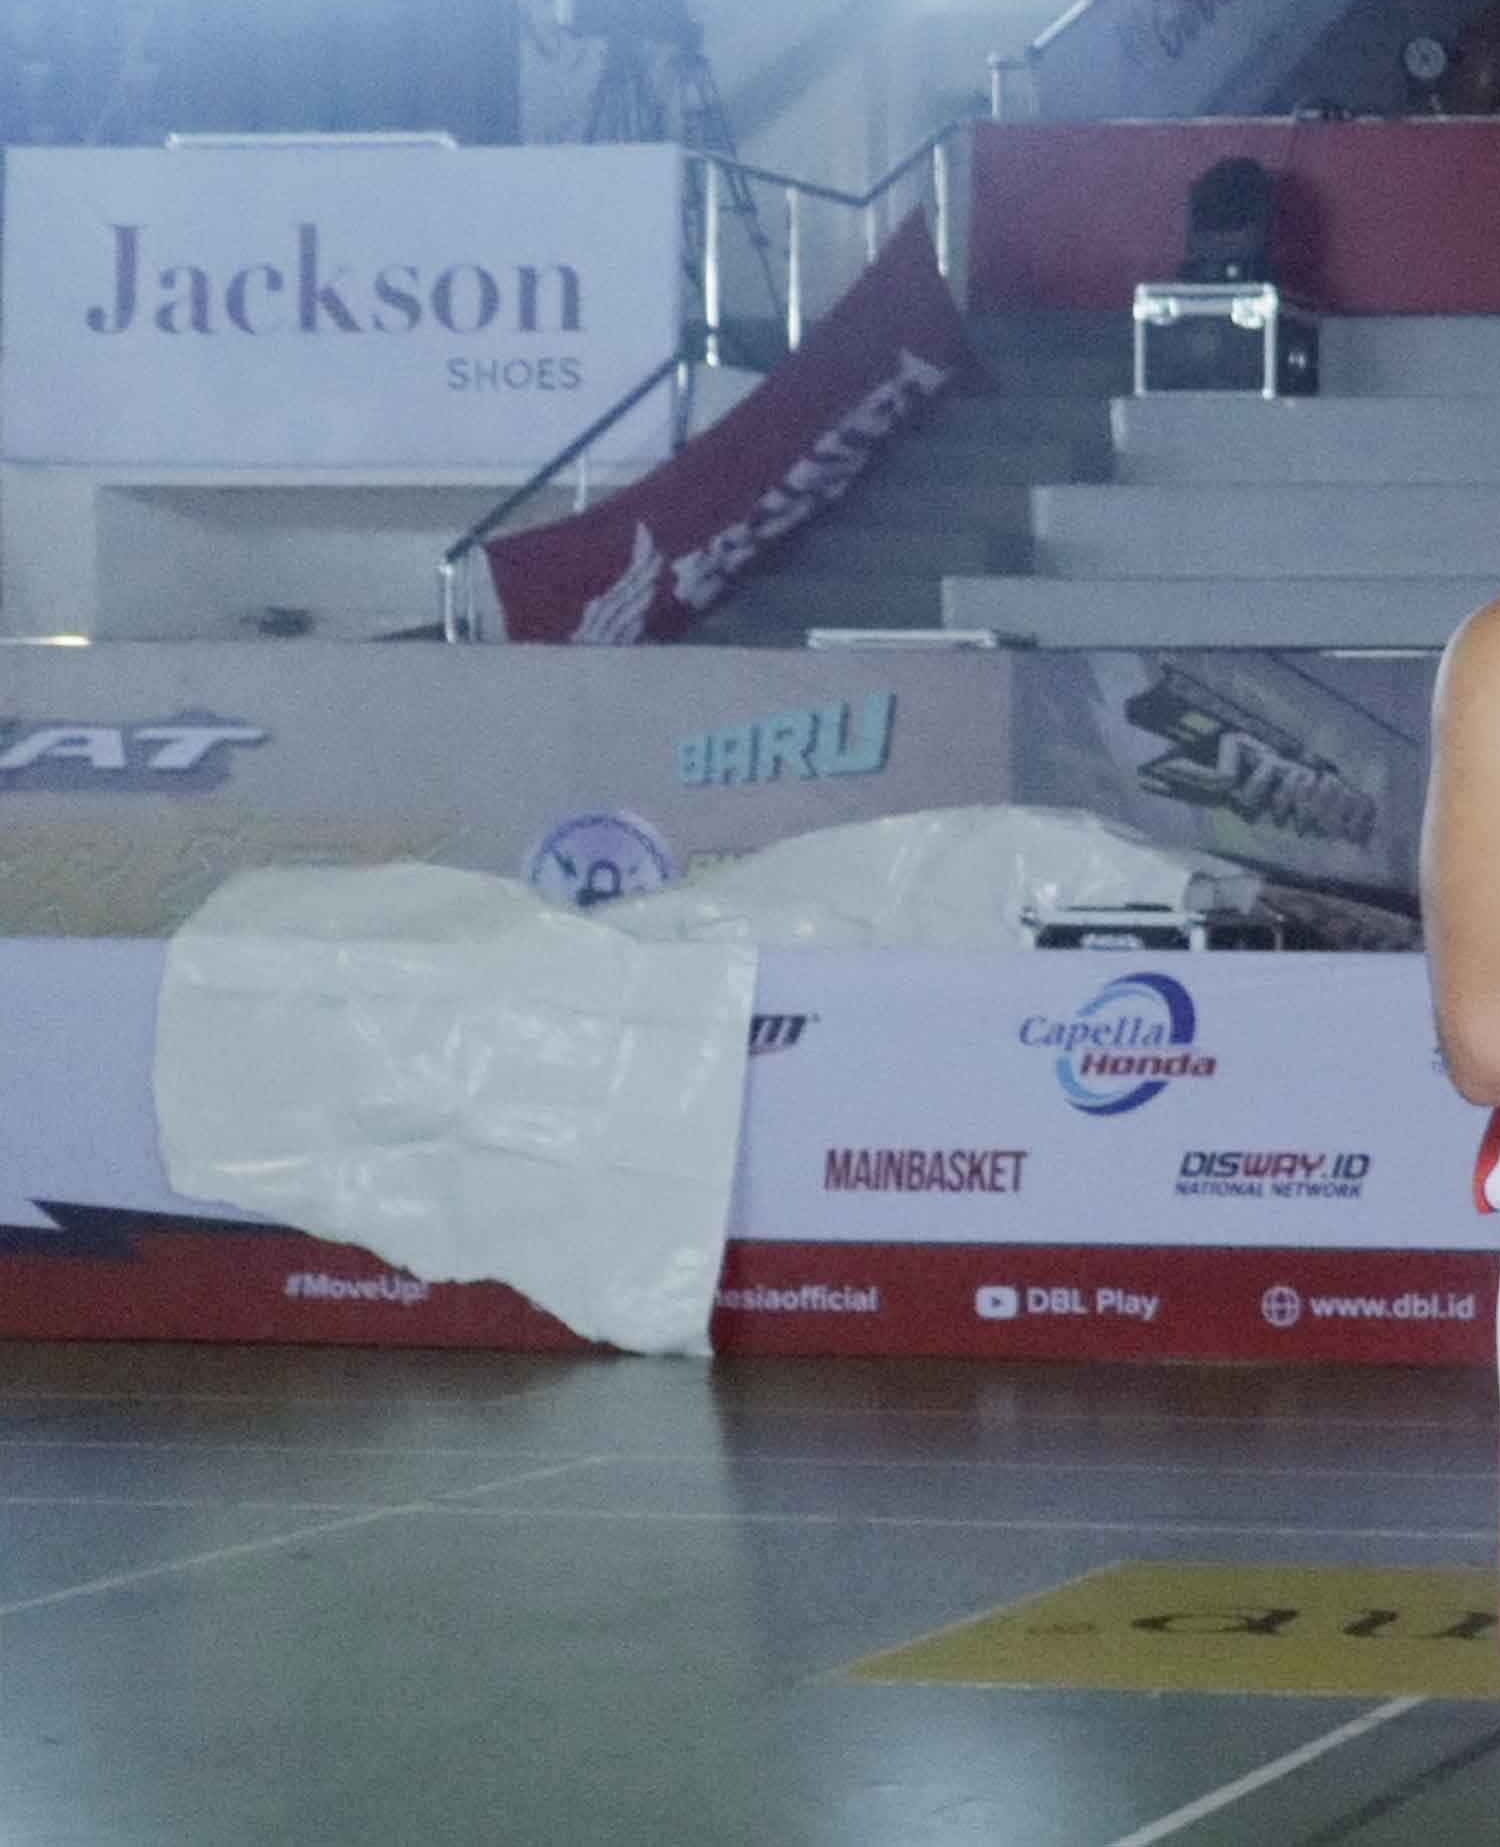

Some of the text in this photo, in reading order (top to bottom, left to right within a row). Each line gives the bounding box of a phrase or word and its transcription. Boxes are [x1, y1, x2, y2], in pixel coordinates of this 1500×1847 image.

[84, 221, 586, 338] Jackson
[446, 358, 583, 392] SHOES
[1018, 1016, 1169, 1061] Capella
[1079, 1052, 1217, 1079] Honda
[824, 1149, 1028, 1194] MAINBASKET
[1179, 1151, 1370, 1180] DISWAY.ID
[1174, 1180, 1363, 1199] NATIONAL NETWORK
[1027, 1289, 1159, 1321] DBL Play
[1309, 1293, 1475, 1320] www.dbl.id
